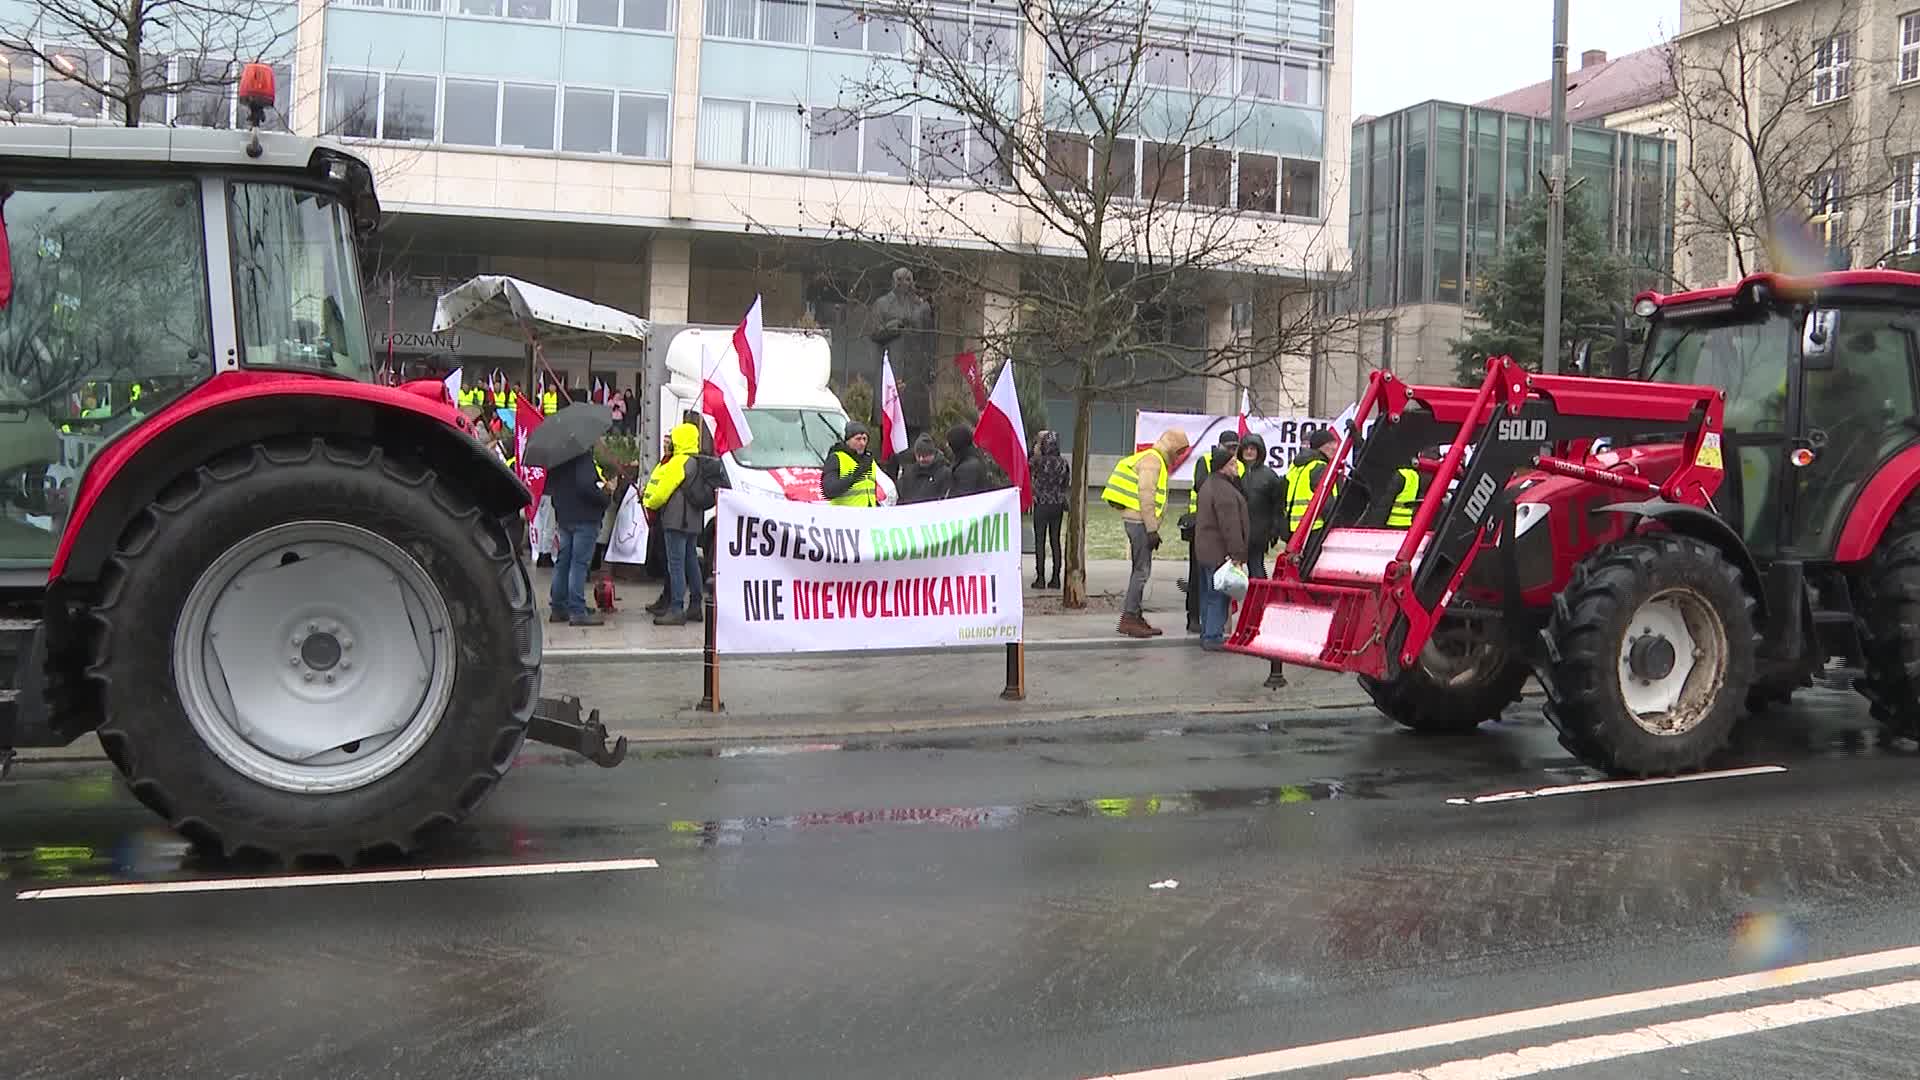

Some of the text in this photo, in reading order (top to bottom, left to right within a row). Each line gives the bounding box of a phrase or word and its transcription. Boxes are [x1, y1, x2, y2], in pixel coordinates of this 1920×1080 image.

[381, 332, 461, 349] POZNANU
[1498, 419, 1547, 440] SOLID
[1463, 472, 1497, 524] 1000
[728, 511, 1010, 564] JESTEŚMY ROLNIKAMI
[743, 574, 998, 622] NIE NIEWOLNIKAMI!
[958, 624, 1017, 640] ROLNICY PCT
